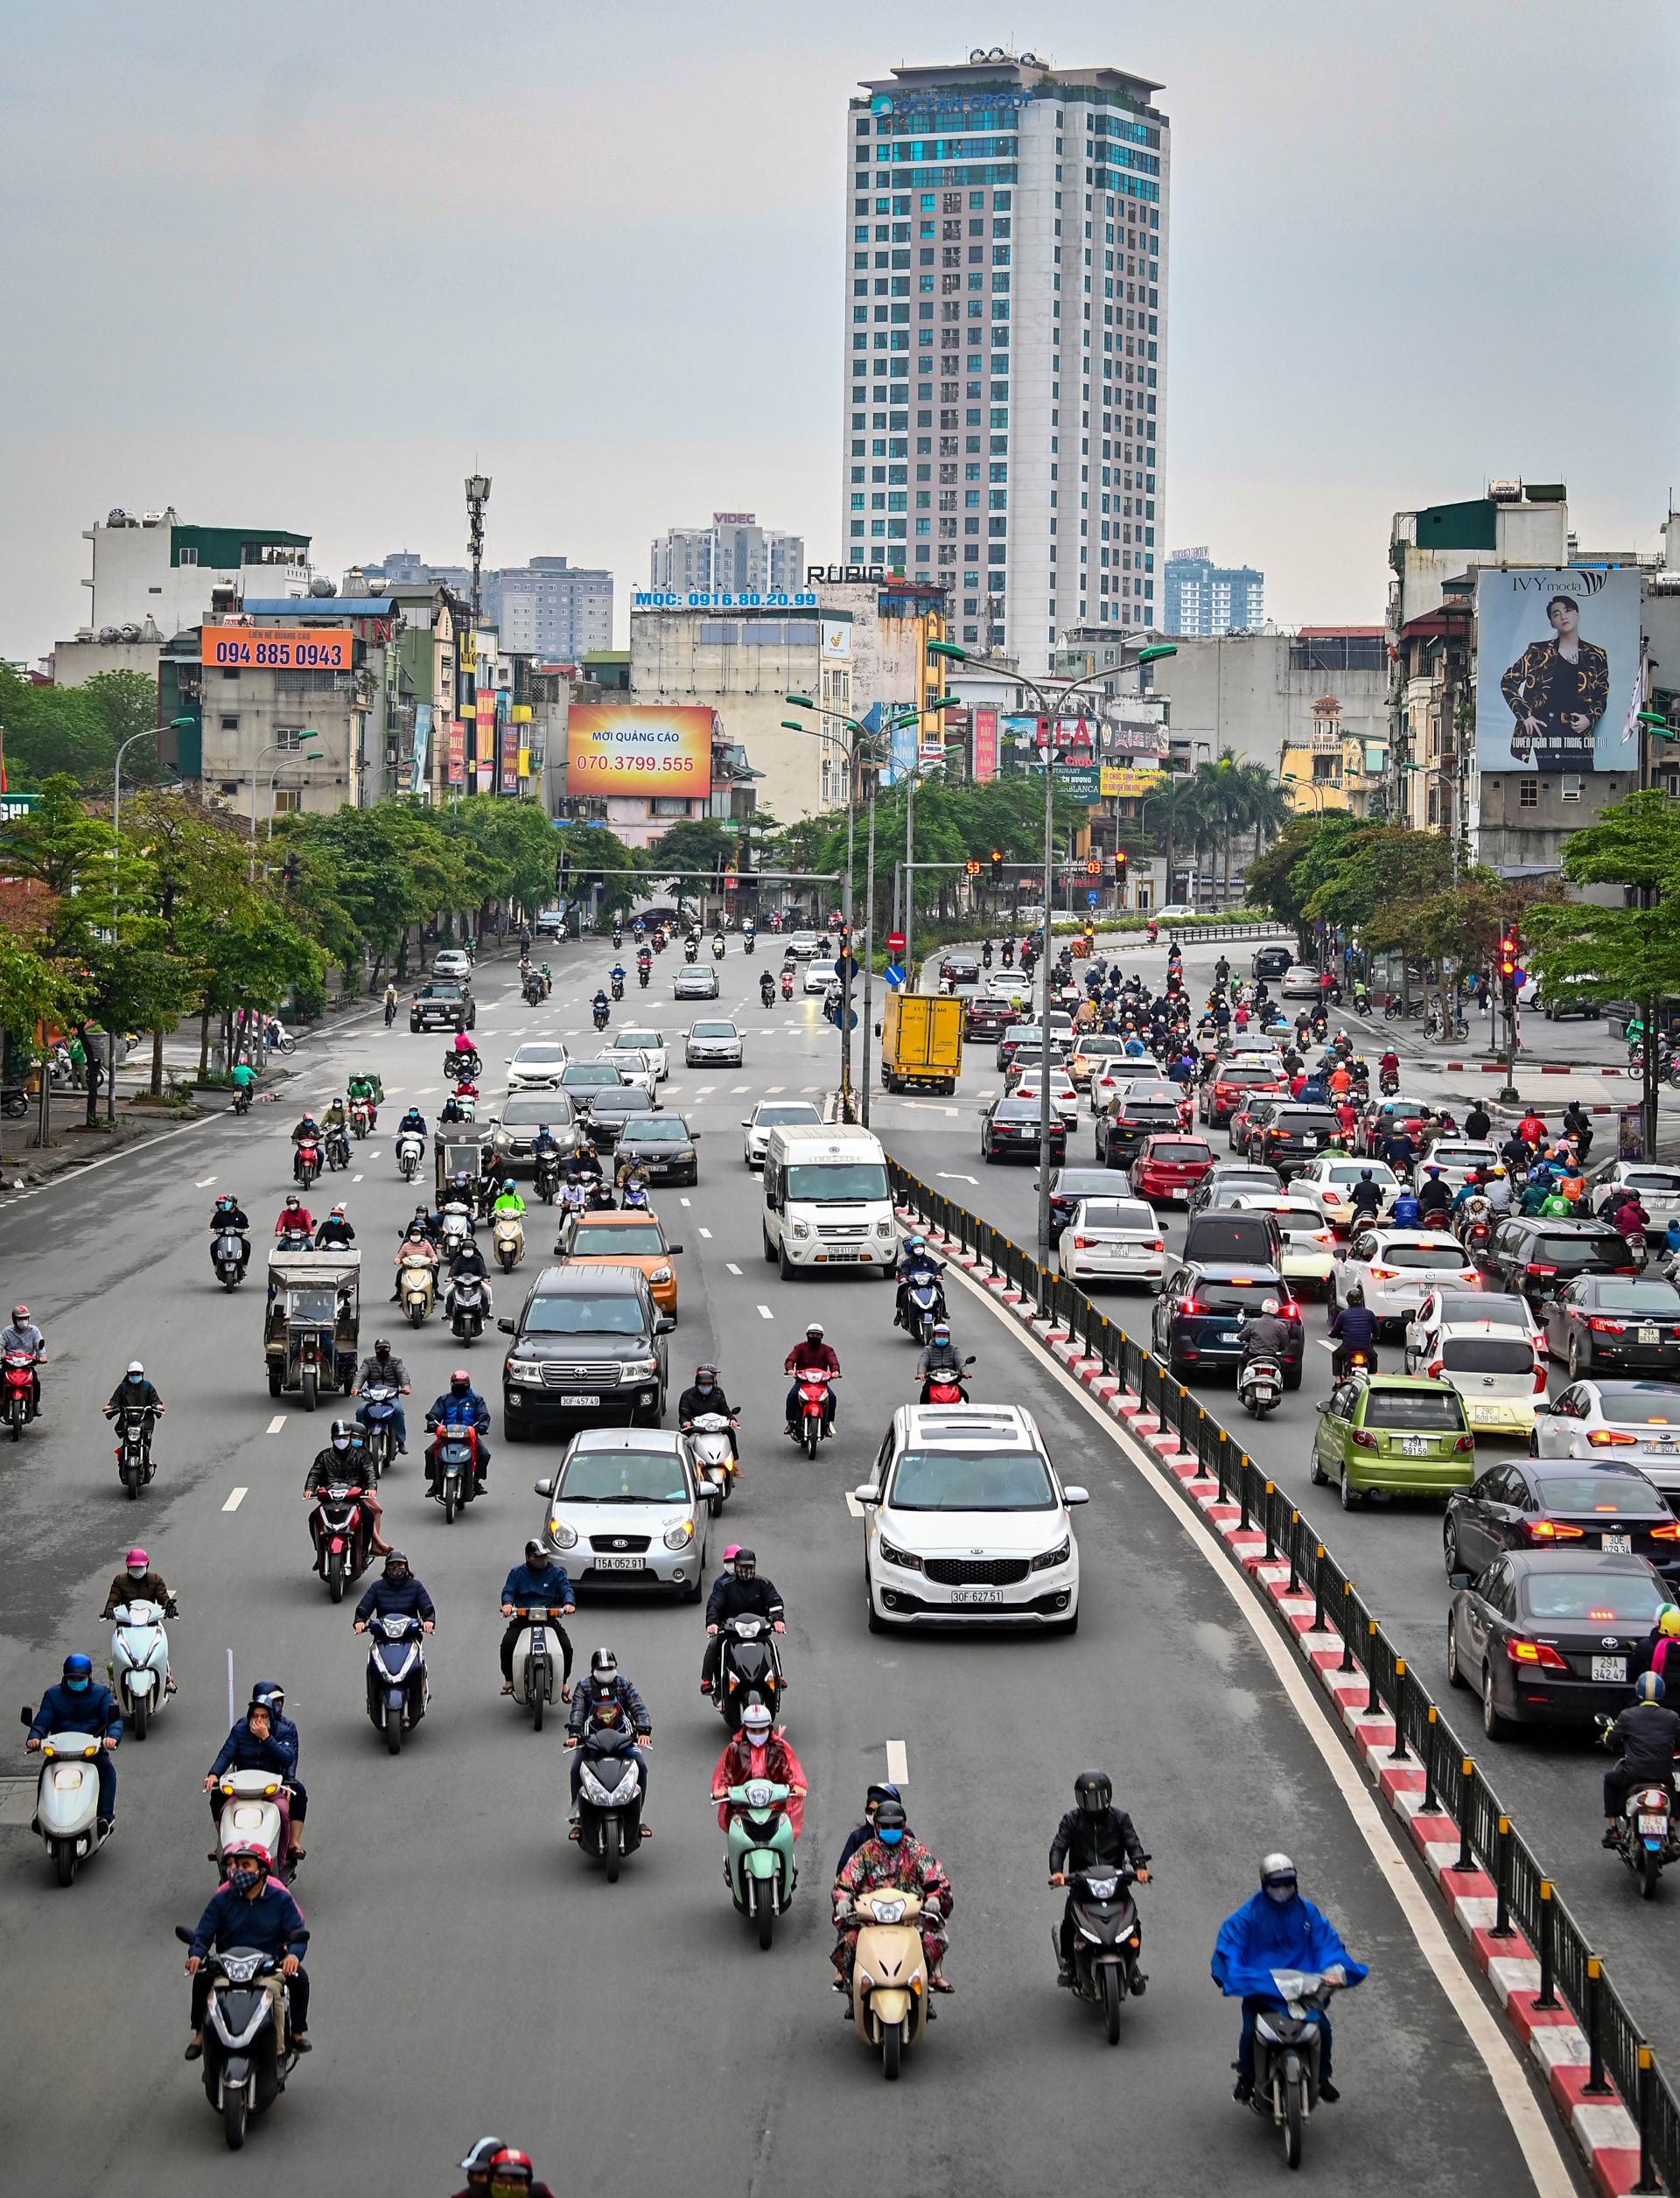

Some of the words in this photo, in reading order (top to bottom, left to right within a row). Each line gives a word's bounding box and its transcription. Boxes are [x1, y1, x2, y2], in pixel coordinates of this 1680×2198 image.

[898, 95, 962, 115] OCEAN
[969, 91, 1035, 110] GROUP
[713, 513, 755, 524] VIDEC
[1513, 578, 1547, 592] IVY
[1547, 581, 1581, 592] moda
[635, 592, 682, 606] MQC:
[688, 592, 816, 606] 0916.80.20.99
[216, 641, 251, 663] 094
[256, 642, 290, 665] 885
[295, 644, 342, 666] 0943
[980, 724, 991, 737] BẤT
[592, 730, 613, 741] MỜI
[615, 730, 654, 743] QUẢNG
[657, 732, 680, 742] CÁO
[577, 755, 694, 772] 070.3799.555
[967, 863, 980, 874] 53
[1088, 863, 1101, 874] 03
[1409, 1438, 1422, 1447] 29A
[1404, 1446, 1427, 1456] 591.59
[1644, 1444, 1680, 1453] 30F-907.4
[1609, 1536, 1624, 1544] 30E
[1600, 1658, 1618, 1669] 29A
[1593, 1669, 1626, 1681] 342.47
